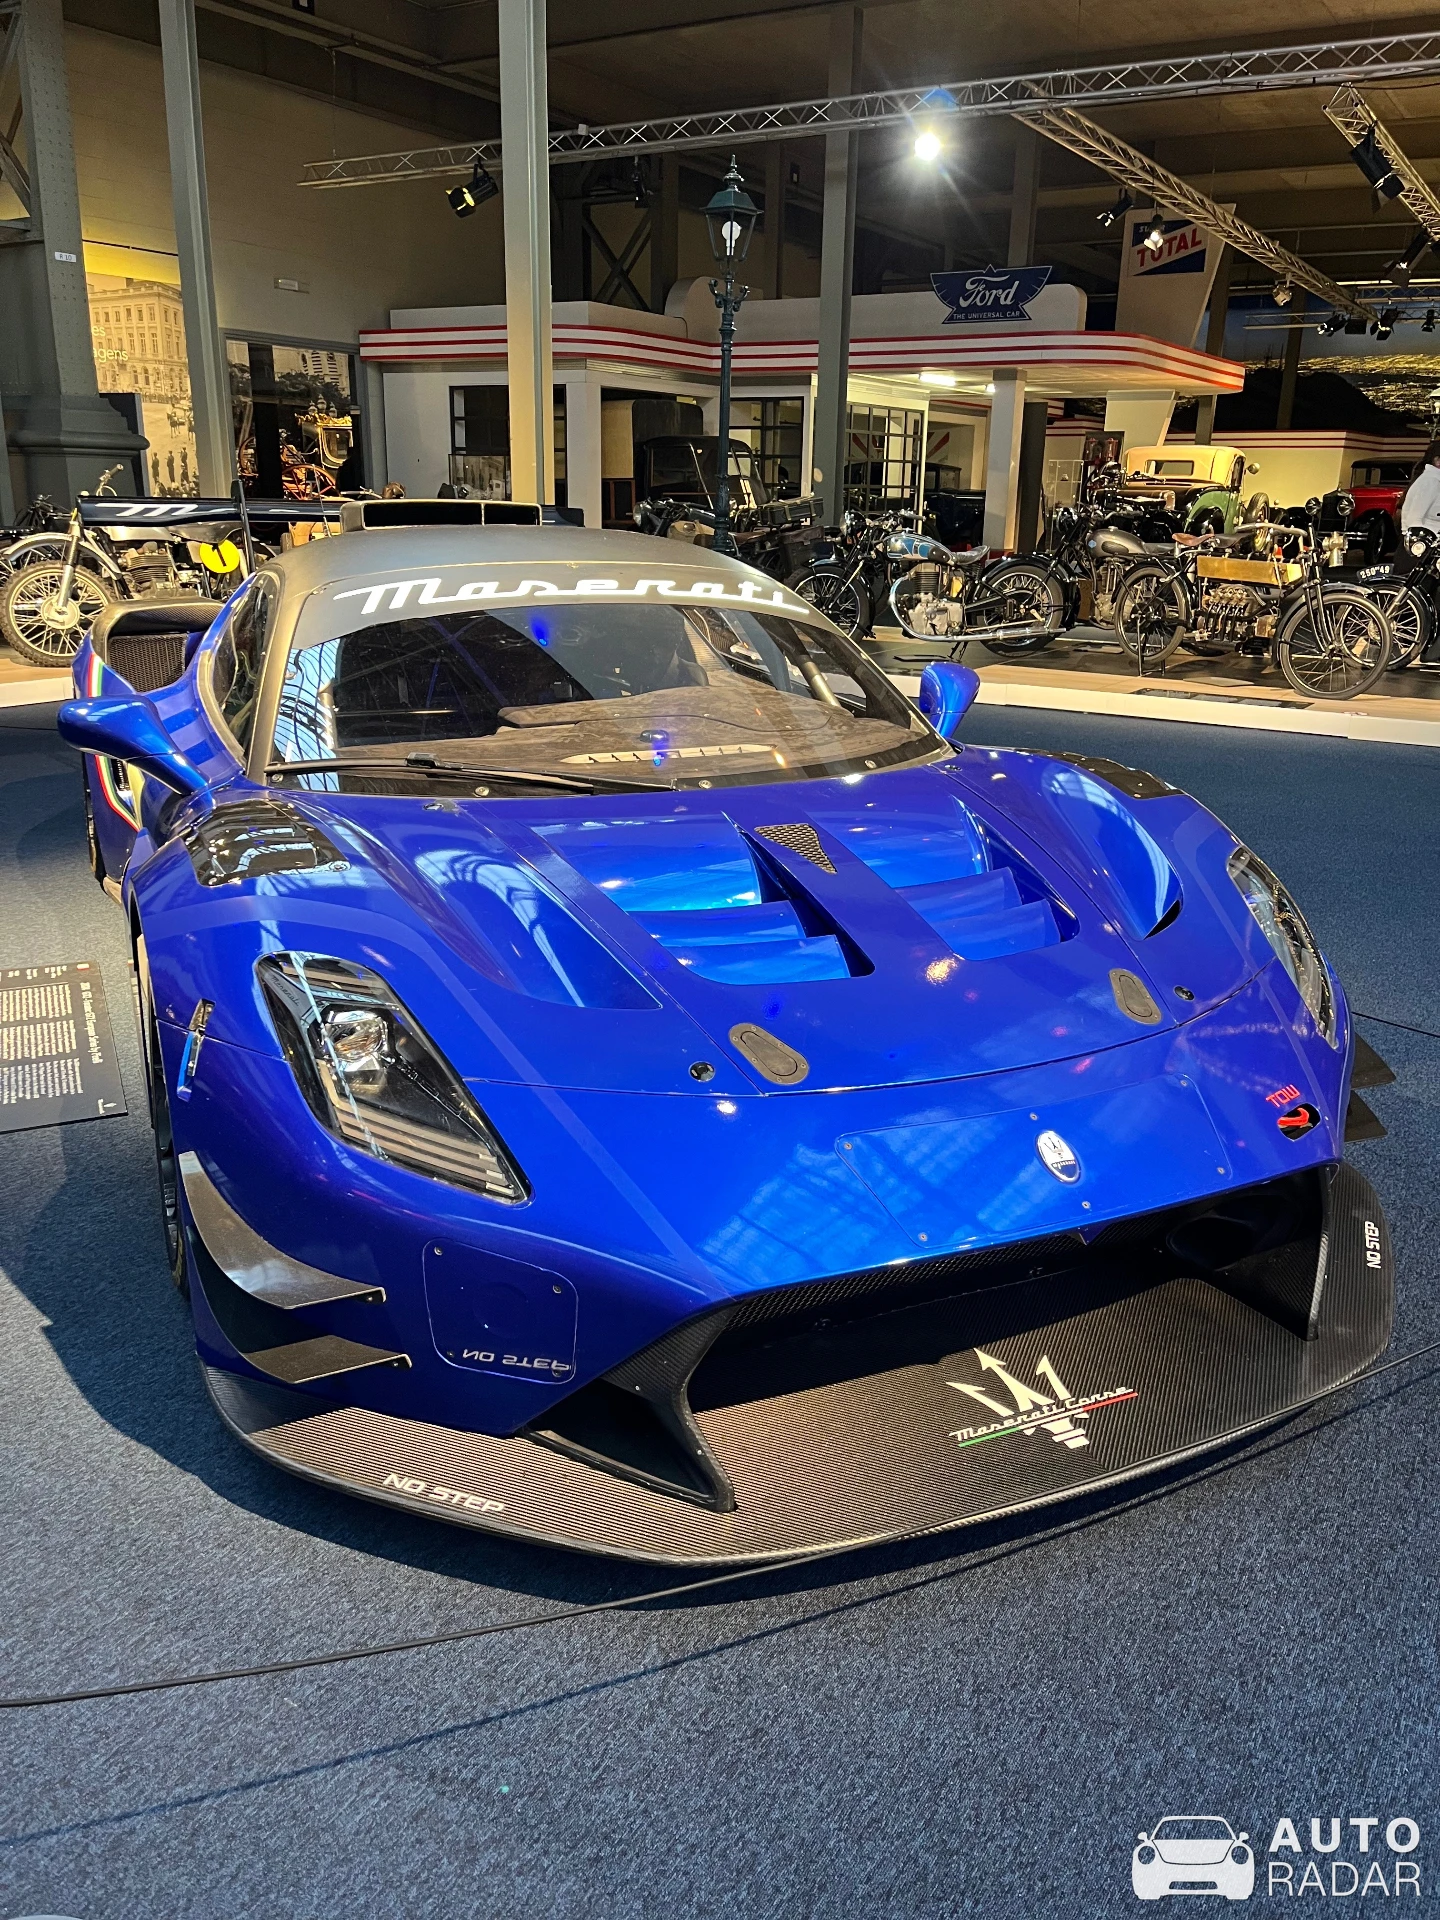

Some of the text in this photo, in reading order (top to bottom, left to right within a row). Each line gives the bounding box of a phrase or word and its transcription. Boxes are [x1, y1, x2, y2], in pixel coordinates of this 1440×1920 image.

[1136, 228, 1202, 267] TOTAL
[959, 275, 1020, 307] Ford
[333, 577, 810, 615] Maserati
[1265, 1084, 1301, 1108] TOW
[1364, 1220, 1382, 1269] NO STEP
[948, 1386, 1134, 1441] Maserati Corse
[382, 1473, 505, 1511] NO STEP
